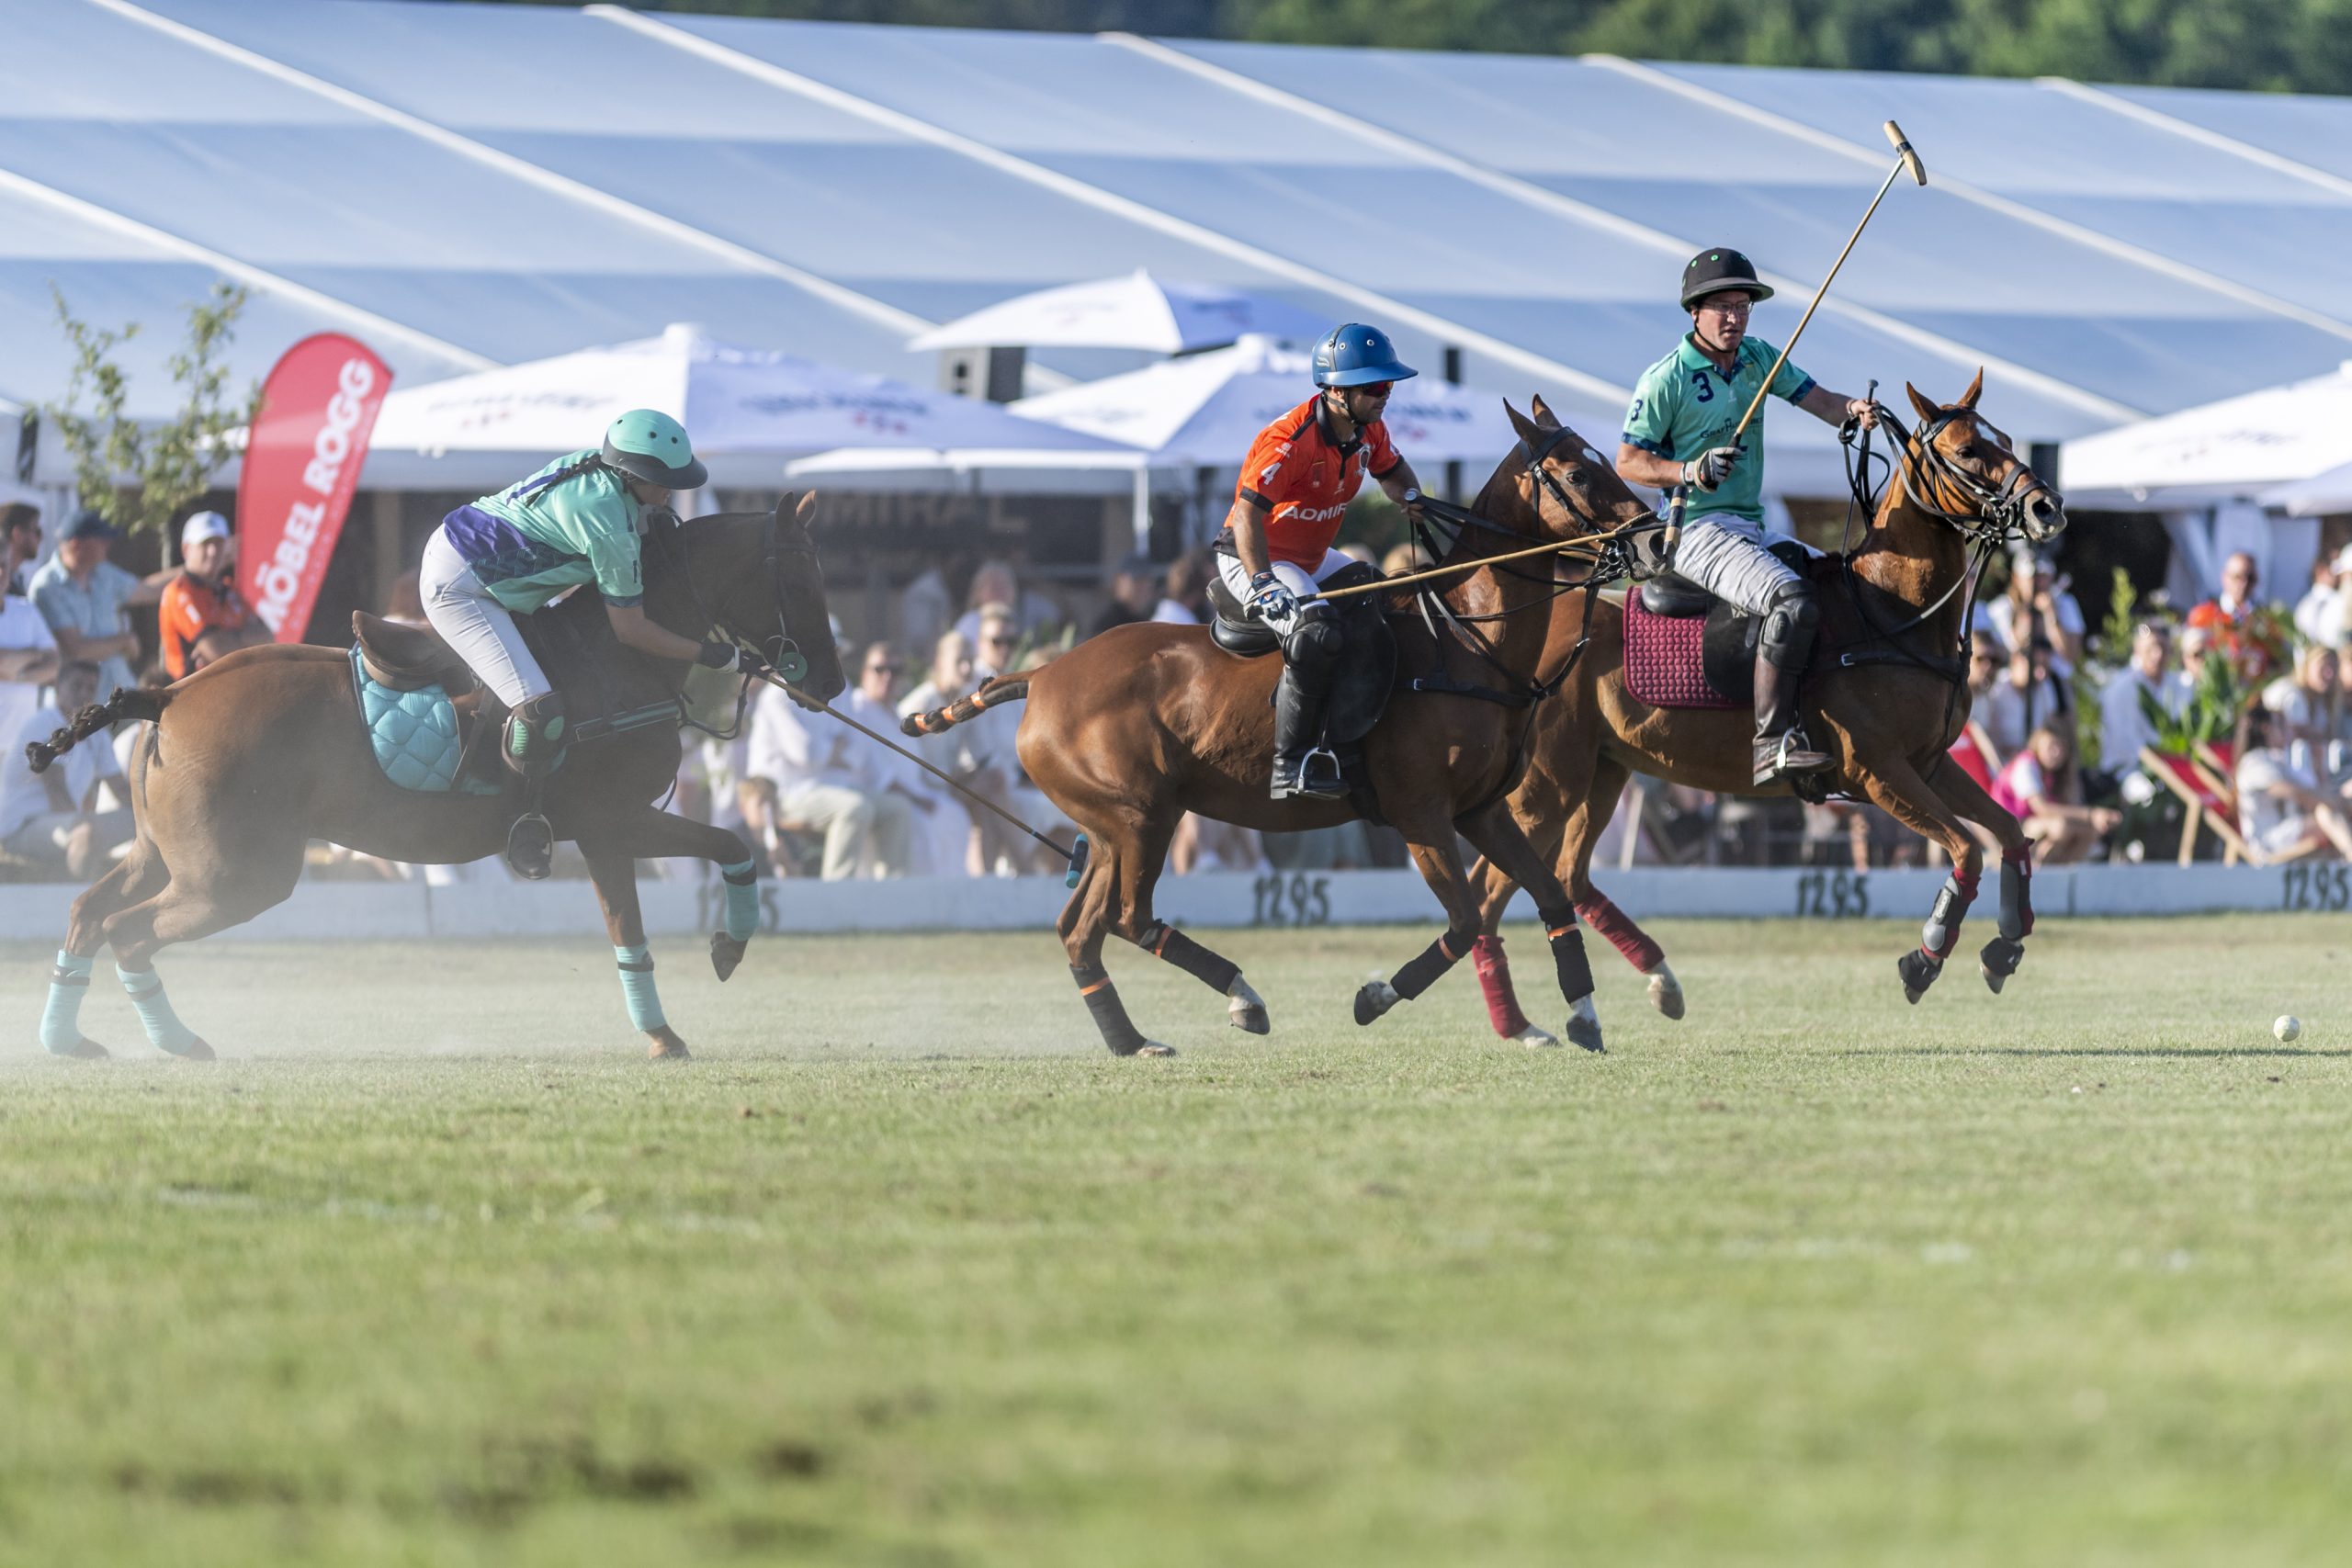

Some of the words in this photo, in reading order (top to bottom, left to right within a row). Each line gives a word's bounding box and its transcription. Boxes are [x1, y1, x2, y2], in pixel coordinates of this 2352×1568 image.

[1691, 371, 1715, 403] 3
[1630, 399, 1644, 422] 3
[302, 357, 375, 495] ROGG
[1261, 461, 1282, 485] 4
